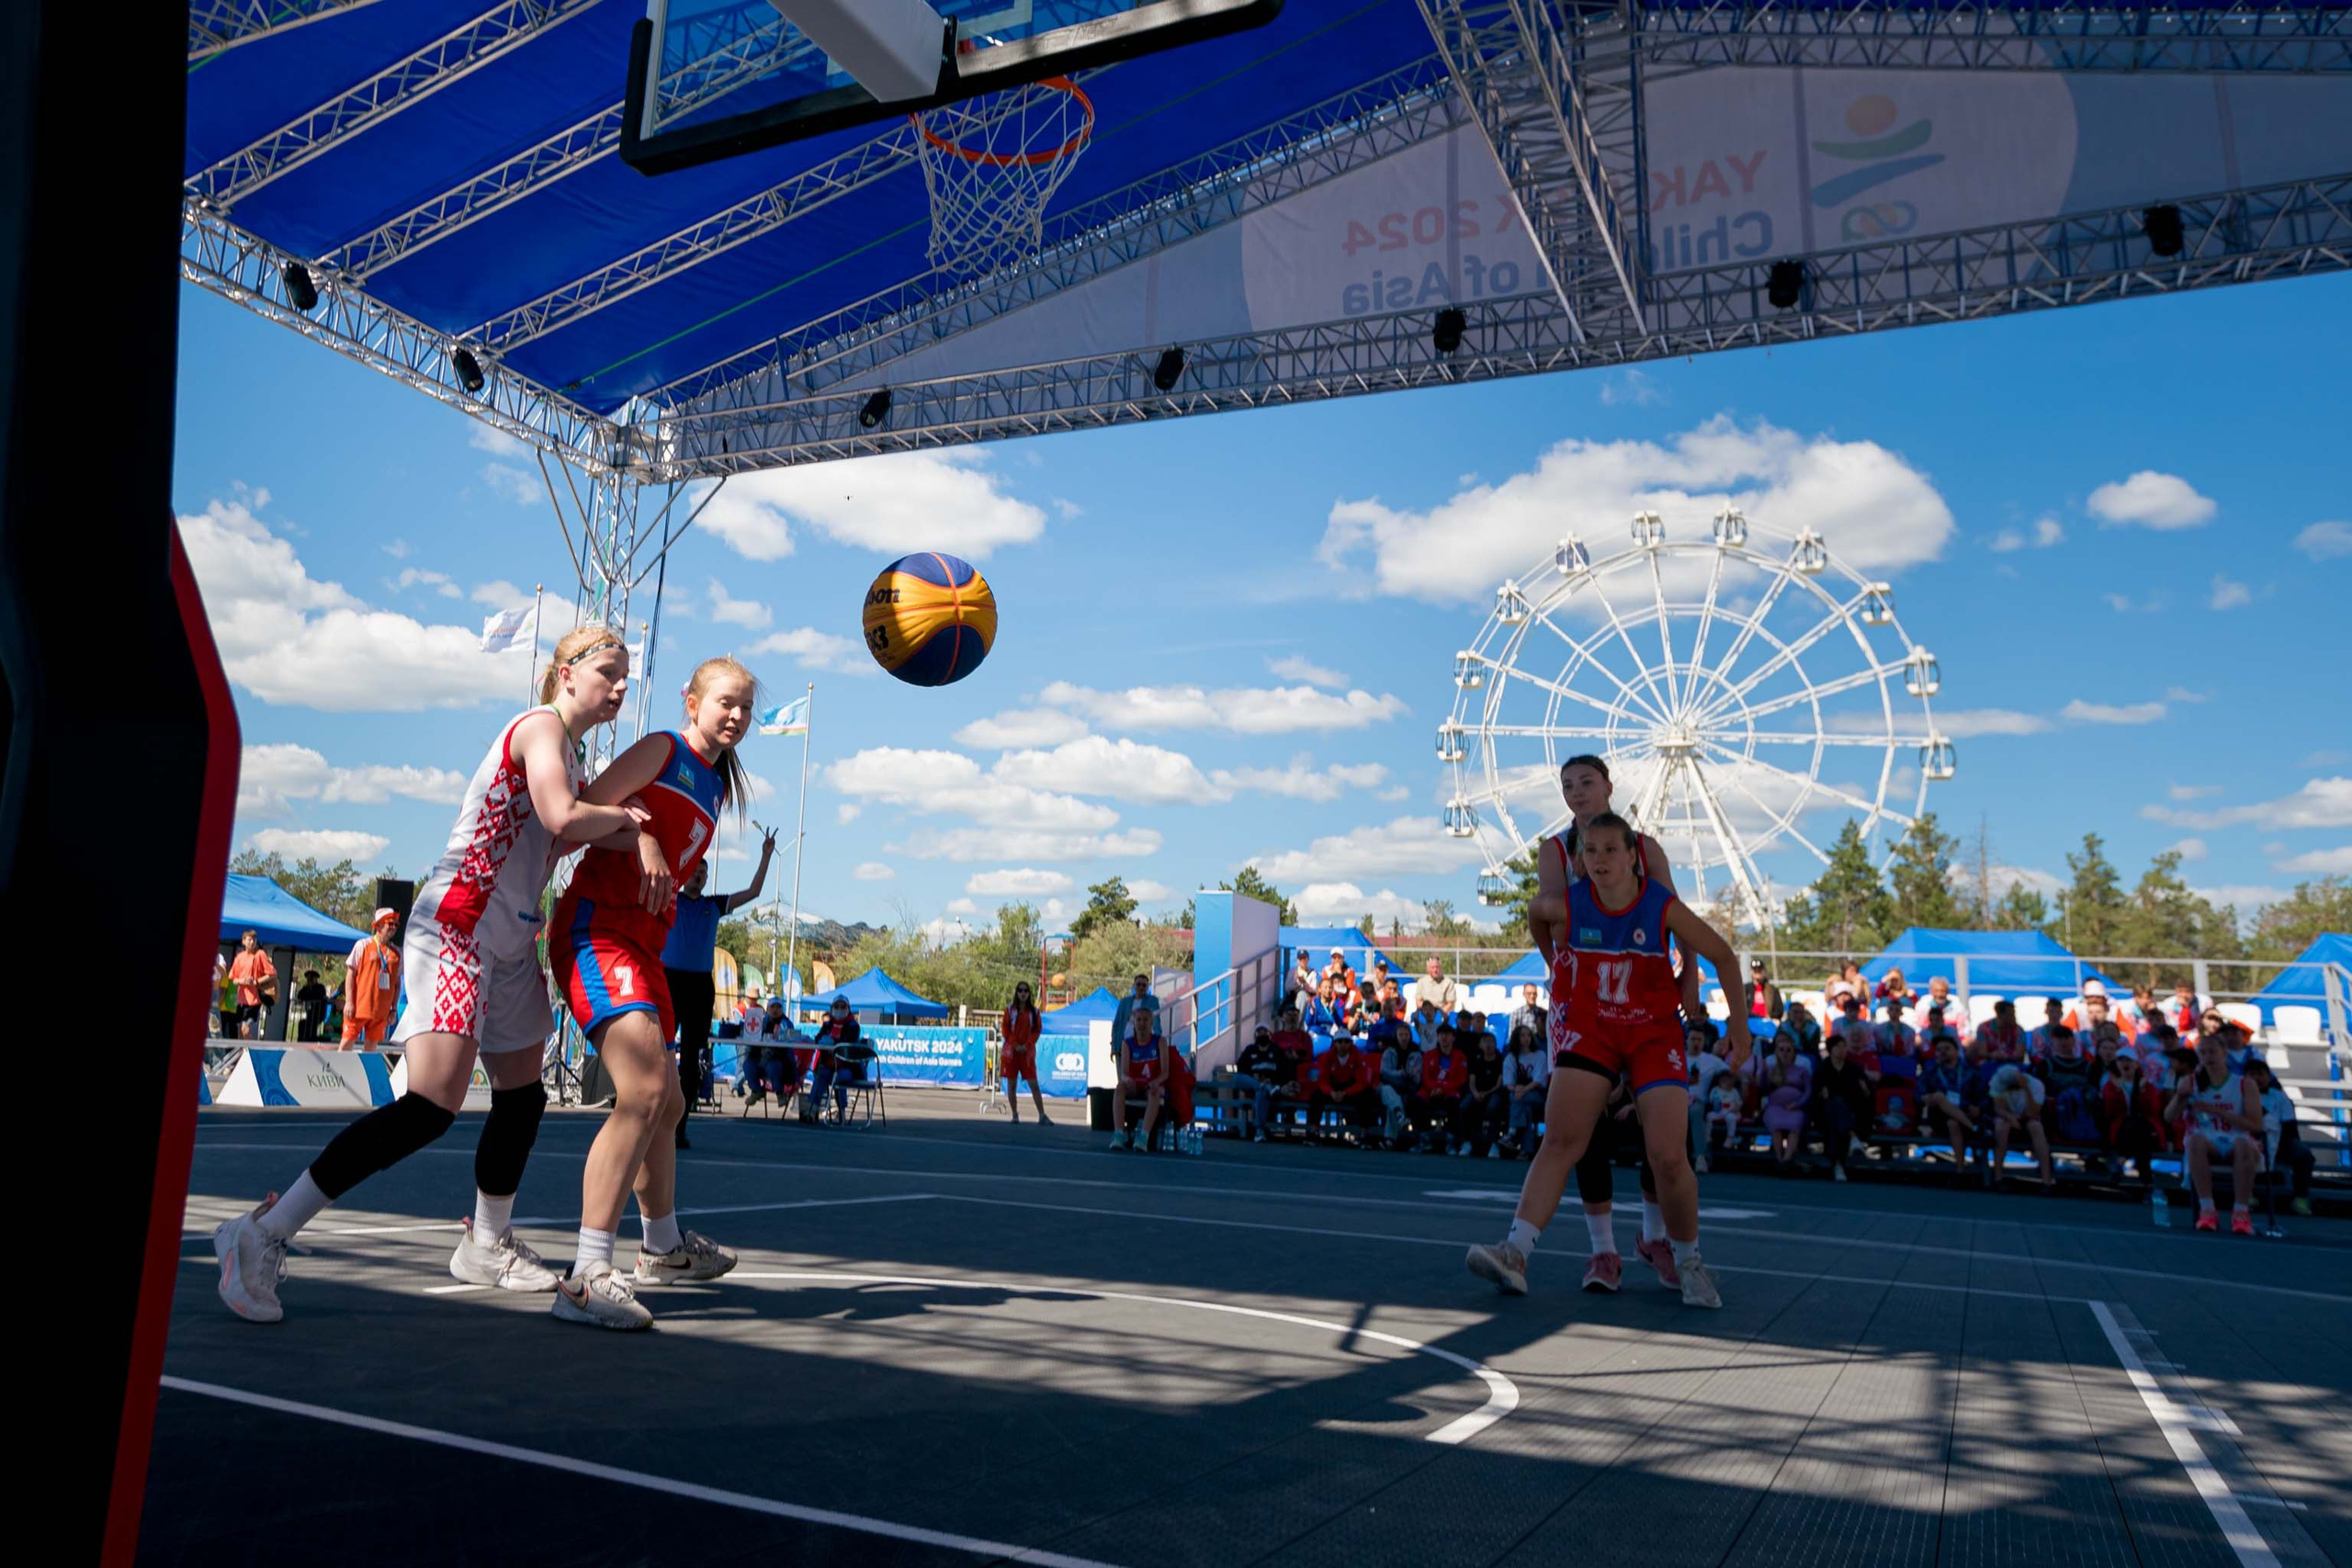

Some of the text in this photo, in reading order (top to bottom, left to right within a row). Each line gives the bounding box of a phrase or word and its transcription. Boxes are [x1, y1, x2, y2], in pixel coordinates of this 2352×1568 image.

[679, 817, 708, 871] 7
[614, 966, 634, 998] 7
[1597, 959, 1633, 1004] 17
[876, 1038, 964, 1055] YAKUTSK 2024
[888, 1055, 914, 1066] Children
[915, 1056, 922, 1066] of
[923, 1056, 938, 1066] Asia
[939, 1057, 963, 1067] Games
[1141, 1064, 1151, 1079] 4
[306, 1073, 345, 1088] КИВИ
